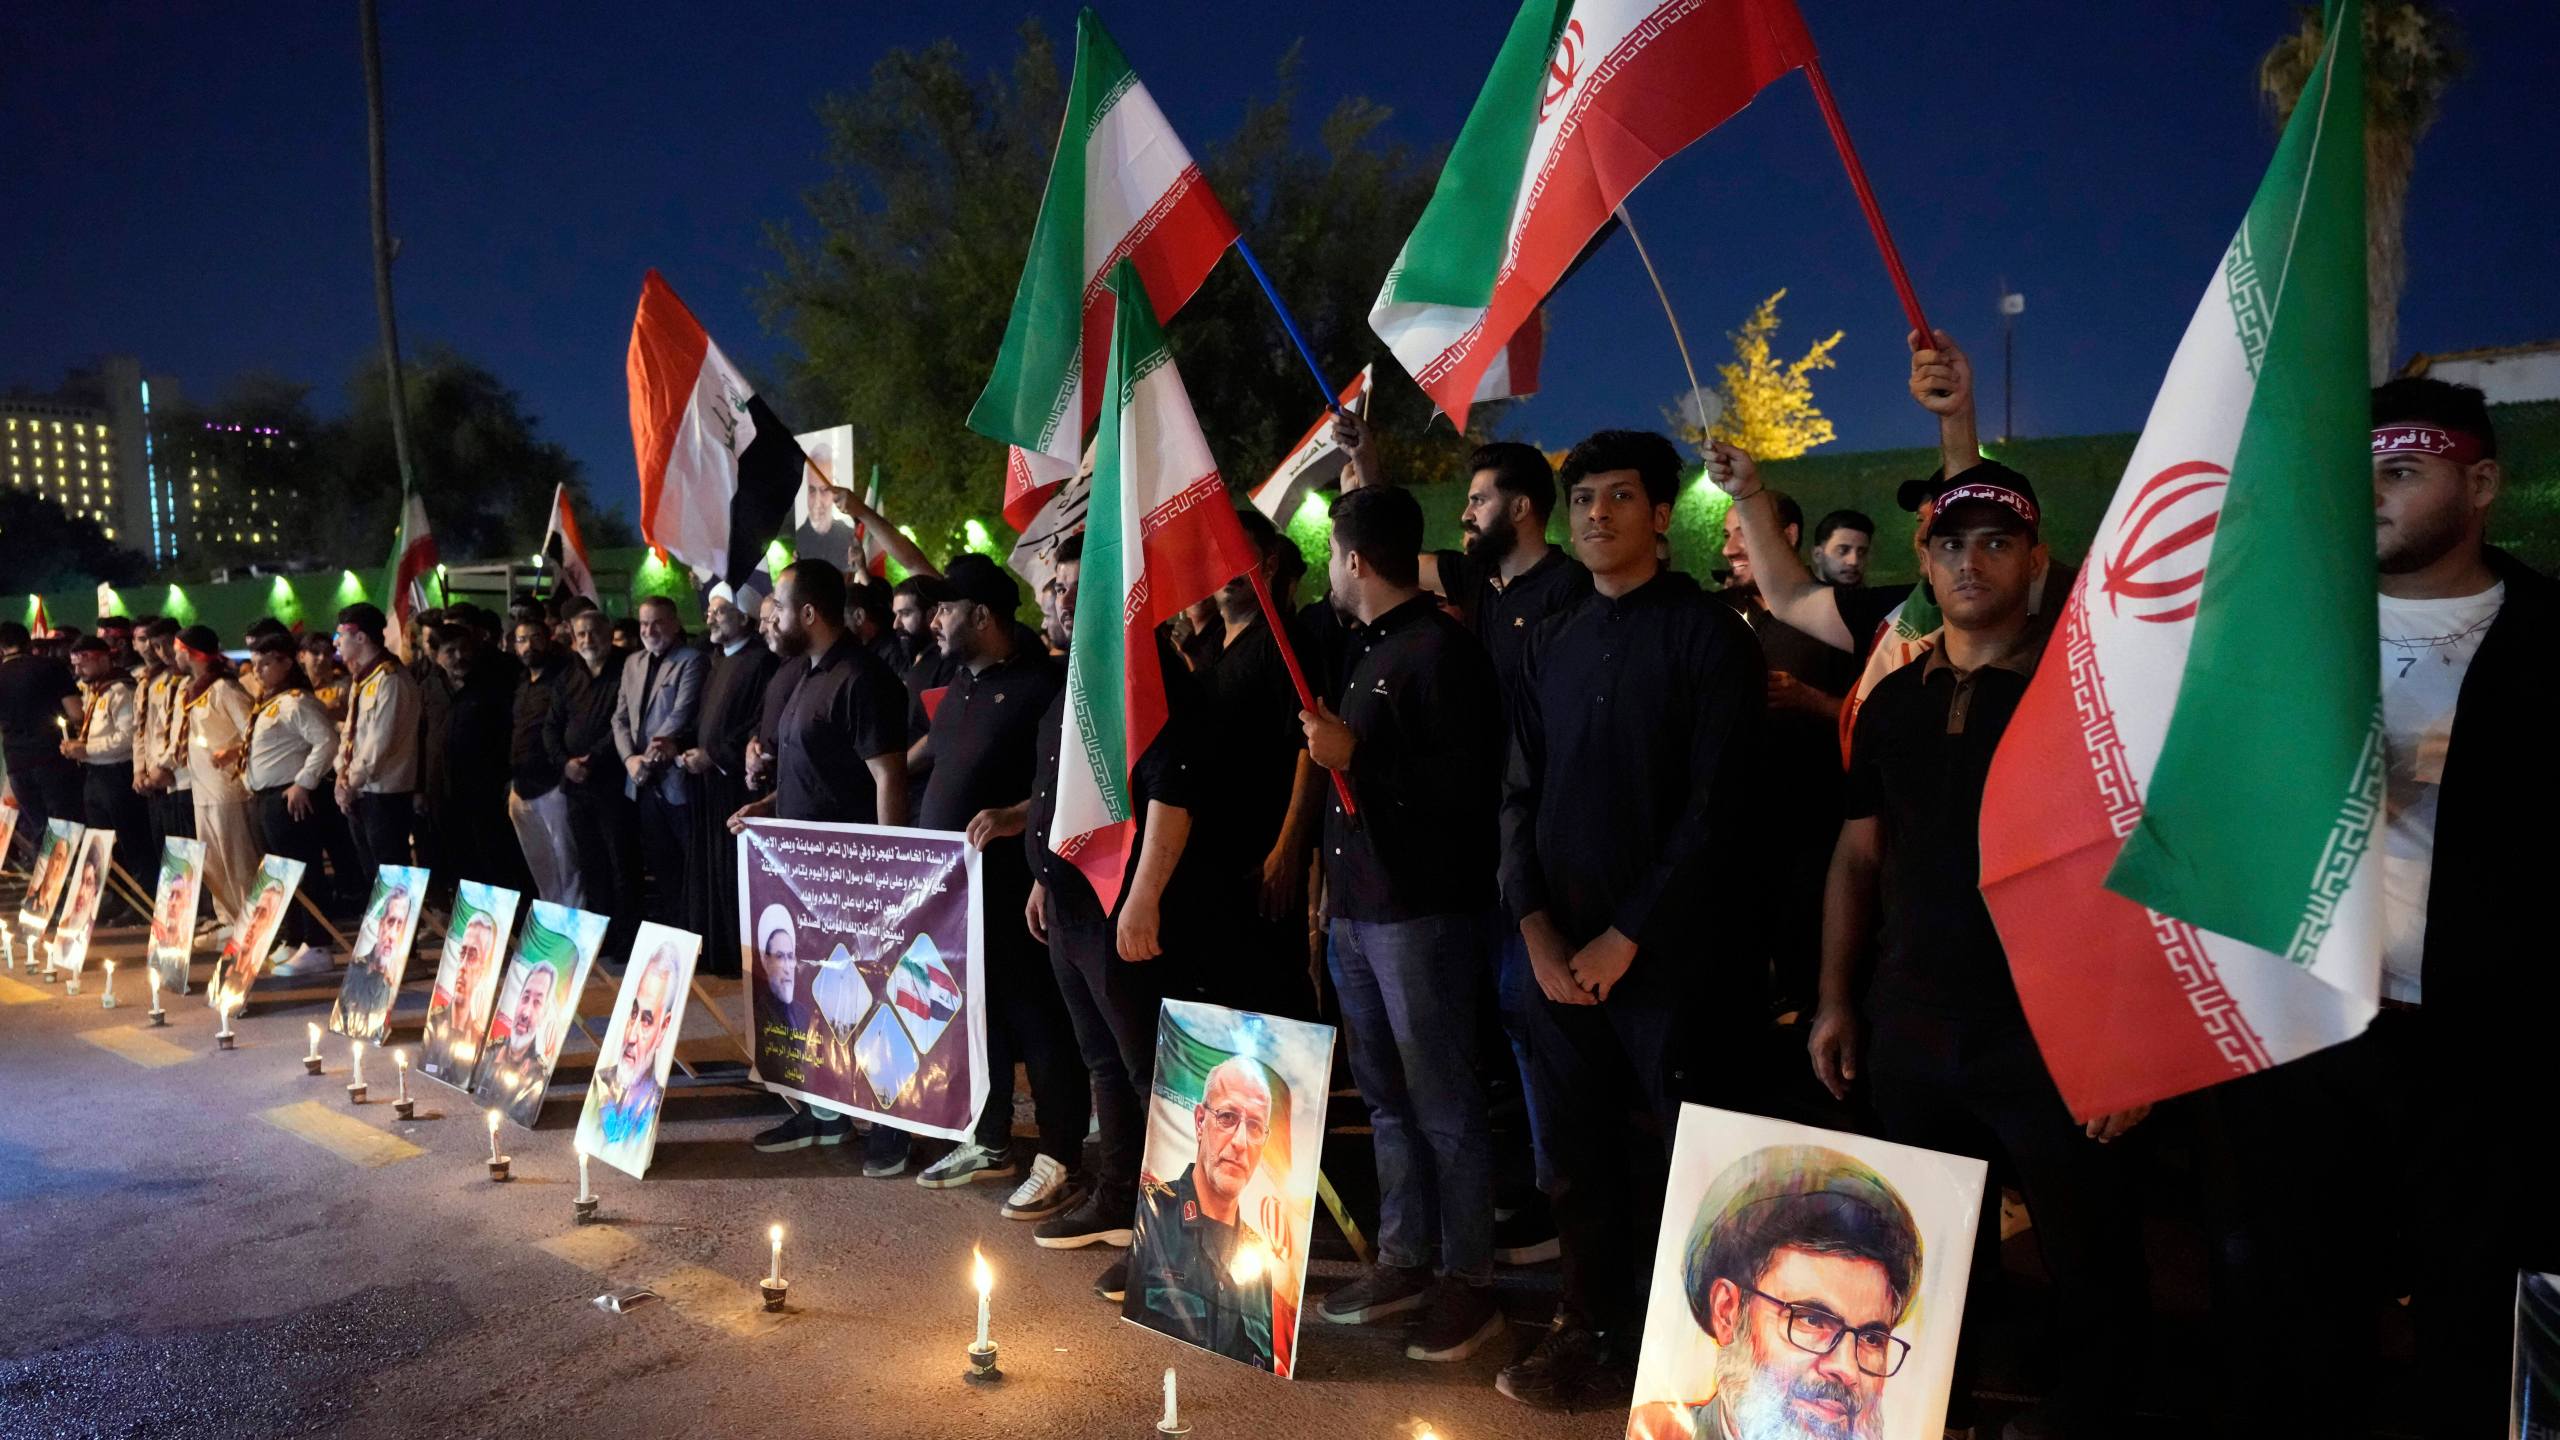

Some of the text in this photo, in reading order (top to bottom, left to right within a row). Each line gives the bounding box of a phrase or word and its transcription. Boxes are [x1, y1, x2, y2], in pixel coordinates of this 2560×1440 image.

[2388, 429, 2417, 449] قمر
[2419, 431, 2431, 449] يا
[1997, 491, 2015, 504] قمر
[2396, 657, 2418, 678] 7
[777, 836, 796, 854] وبعض
[794, 837, 824, 856] الصهاينة
[841, 842, 858, 858] شوال
[859, 843, 870, 863] وفي
[870, 845, 894, 862] للهجرة
[894, 846, 925, 863] الخامسة
[926, 849, 947, 865] السنة
[809, 866, 829, 882] واليوم
[829, 866, 845, 883] الحق
[846, 869, 863, 886] رسول
[864, 870, 875, 884] الله
[876, 872, 889, 891] نبي
[889, 874, 908, 891] وعلى
[840, 895, 855, 911] على
[869, 921, 880, 937] الله
